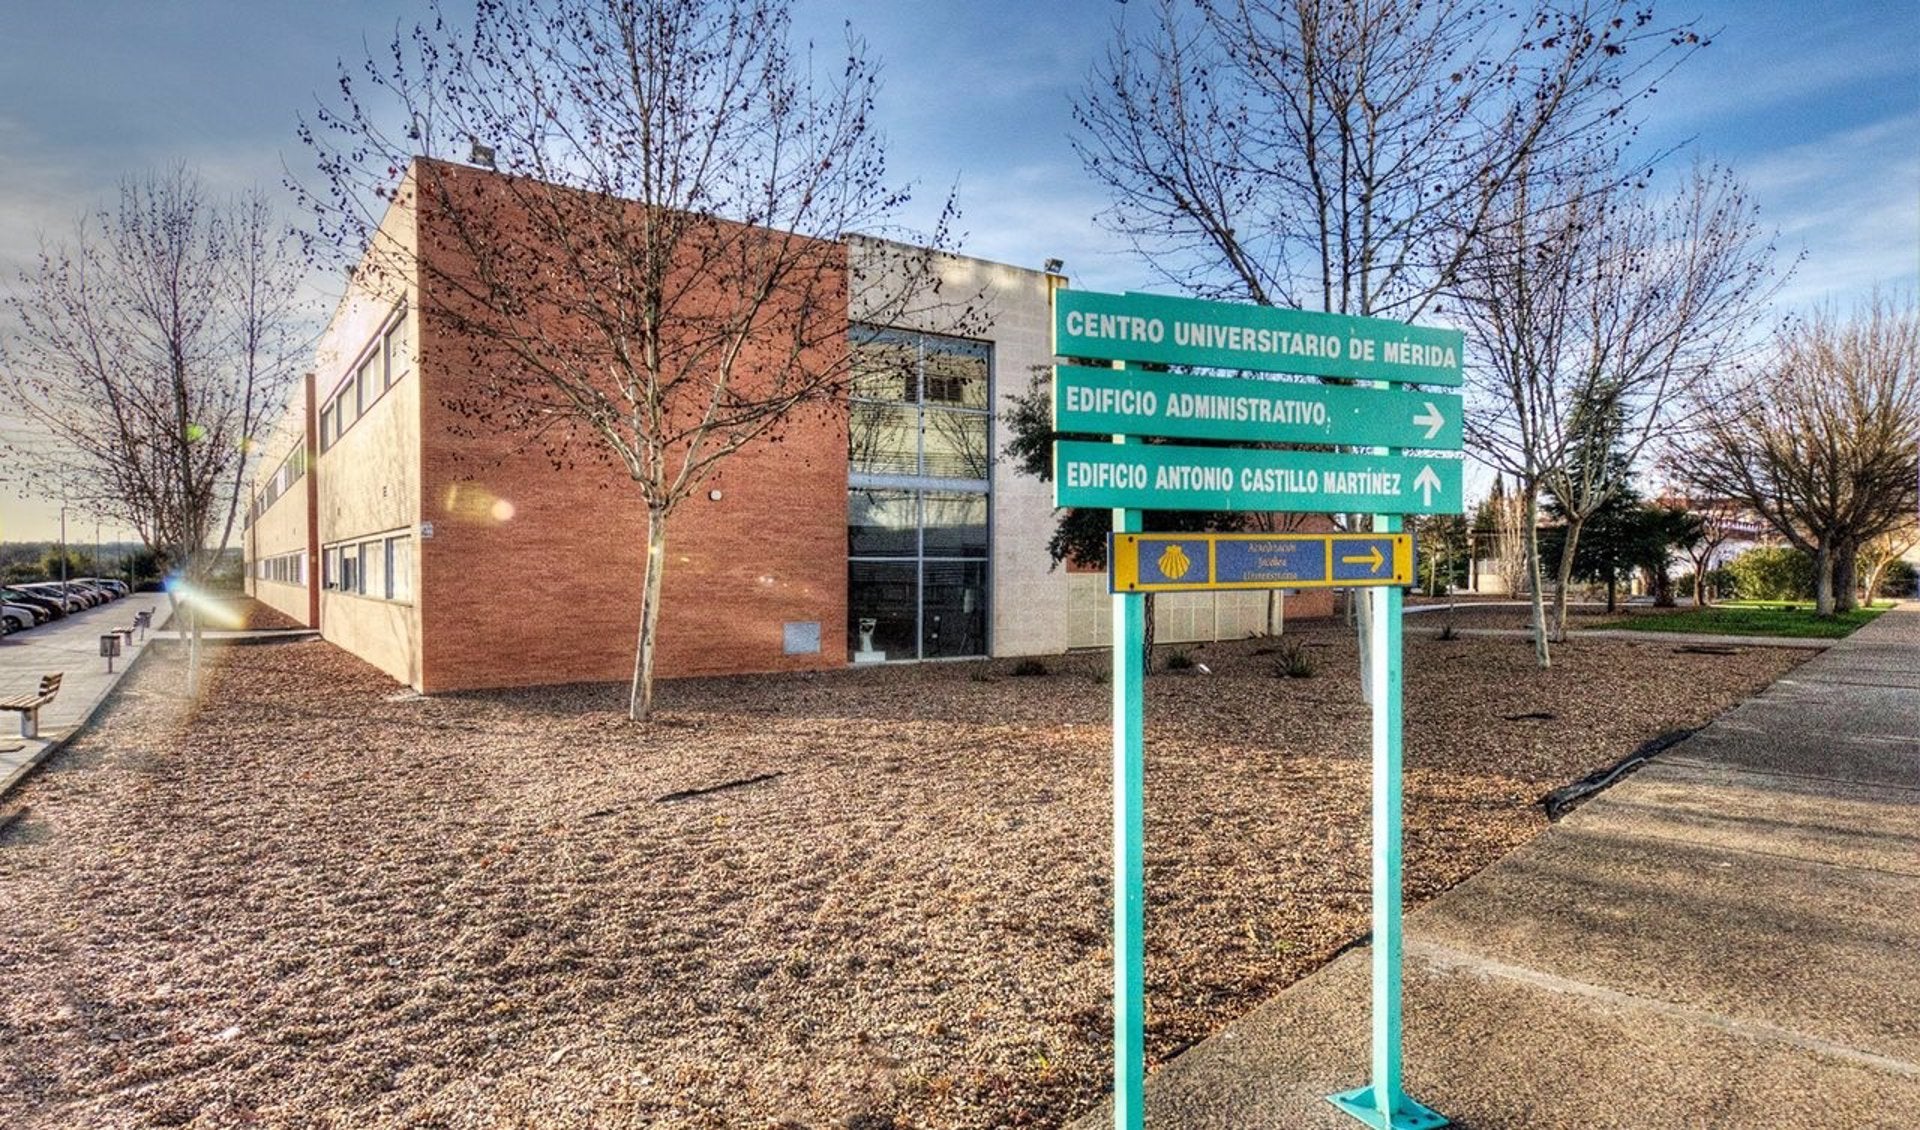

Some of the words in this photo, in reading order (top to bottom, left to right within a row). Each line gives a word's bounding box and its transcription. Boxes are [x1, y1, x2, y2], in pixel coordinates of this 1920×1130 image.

[1066, 311, 1164, 343] CENTRO
[1174, 321, 1341, 359] UNIVERSITARIO
[1349, 337, 1375, 362] DE
[1384, 335, 1457, 369] MÉRIDA
[1066, 385, 1157, 416] EDIFICIO
[1166, 393, 1326, 425] ADMINISTRATIVO
[1067, 461, 1147, 490] EDIFICIO
[1155, 465, 1233, 492] ANTONIO
[1241, 467, 1318, 494] CASTILLO
[1323, 467, 1402, 496] MARTÍNEZ
